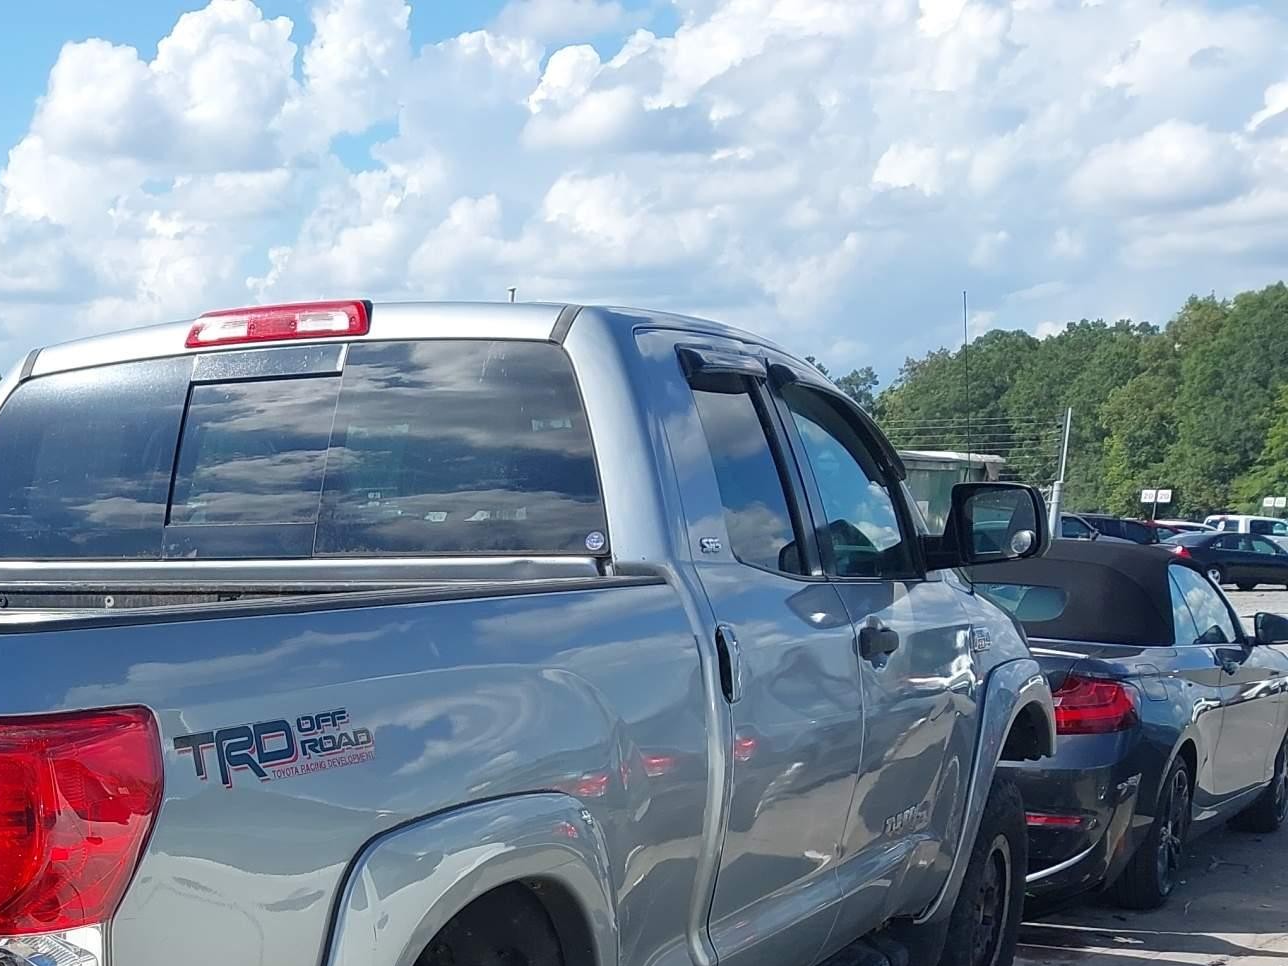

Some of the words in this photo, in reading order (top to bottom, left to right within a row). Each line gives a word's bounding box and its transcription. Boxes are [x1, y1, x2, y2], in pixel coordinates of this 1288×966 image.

[296, 708, 350, 736] OFF
[173, 719, 300, 788] TRD
[300, 727, 374, 759] ROAD
[271, 766, 301, 780] TOYOTA
[300, 759, 327, 775] RACING
[327, 750, 376, 769] DEVELOPMENT
